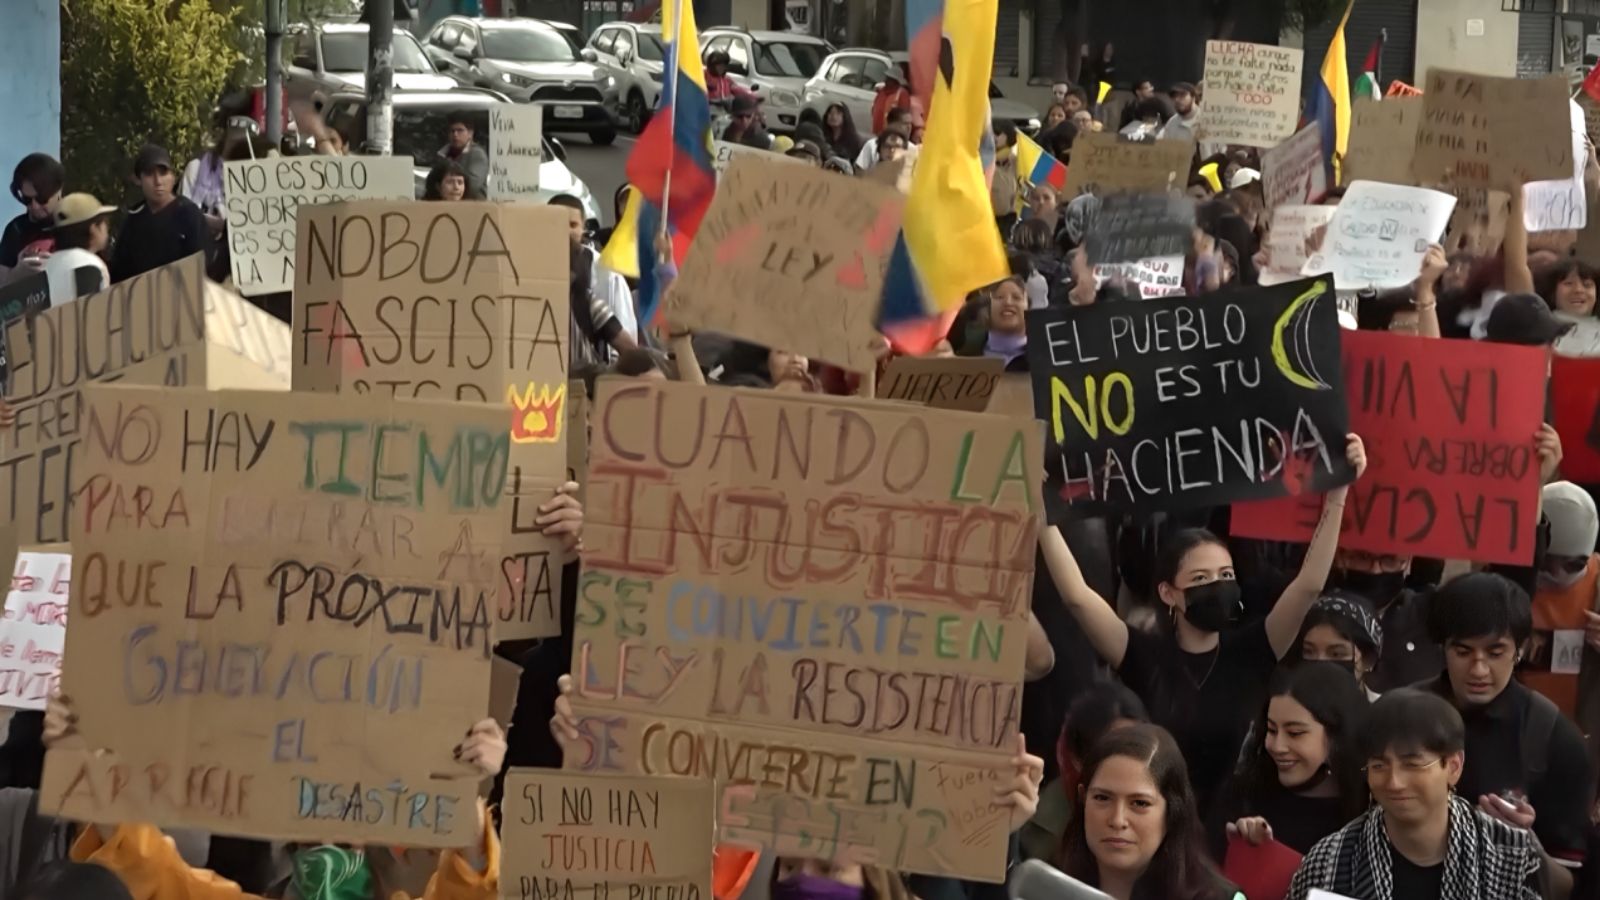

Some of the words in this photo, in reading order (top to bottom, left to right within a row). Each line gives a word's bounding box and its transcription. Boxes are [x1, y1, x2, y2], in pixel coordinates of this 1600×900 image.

[1211, 43, 1255, 55] LUCHA
[228, 164, 267, 195] NO
[310, 160, 367, 190] SOLO
[307, 212, 519, 287] NOBOA
[761, 241, 834, 282] LEY
[302, 295, 565, 373] FASCISTA
[1045, 319, 1099, 366] EL
[1110, 303, 1246, 359] PUEBLO
[1050, 371, 1135, 446] NO
[1155, 364, 1201, 402] ES
[1213, 356, 1261, 394] TU
[1439, 367, 1498, 430] LA
[84, 401, 163, 465] NO
[182, 408, 276, 473] HAY
[288, 421, 511, 509] TIEMPO
[603, 386, 930, 494] CUANDO
[951, 429, 1034, 513] LA
[1061, 407, 1333, 506] HACIENDA
[1403, 436, 1530, 481] OBRERA
[76, 474, 190, 533] PARA
[1455, 492, 1519, 552] LA
[81, 552, 166, 618] QUE
[184, 562, 244, 620] LA
[267, 558, 493, 659] PRÓXIMA
[575, 571, 653, 639] SE
[668, 580, 926, 654] CONVIERTE
[935, 614, 1004, 662] EN
[580, 641, 699, 704] LEY
[707, 648, 770, 717] LA
[792, 658, 1017, 748] RESISTENCIA
[272, 720, 319, 763] EL
[642, 722, 856, 799] CONVIERTE
[865, 758, 916, 809] EN
[297, 778, 461, 834] DESASTRE
[520, 783, 544, 826] SI
[560, 786, 593, 825] NO
[608, 789, 659, 829] HAY
[541, 834, 657, 874] JUSTICIA
